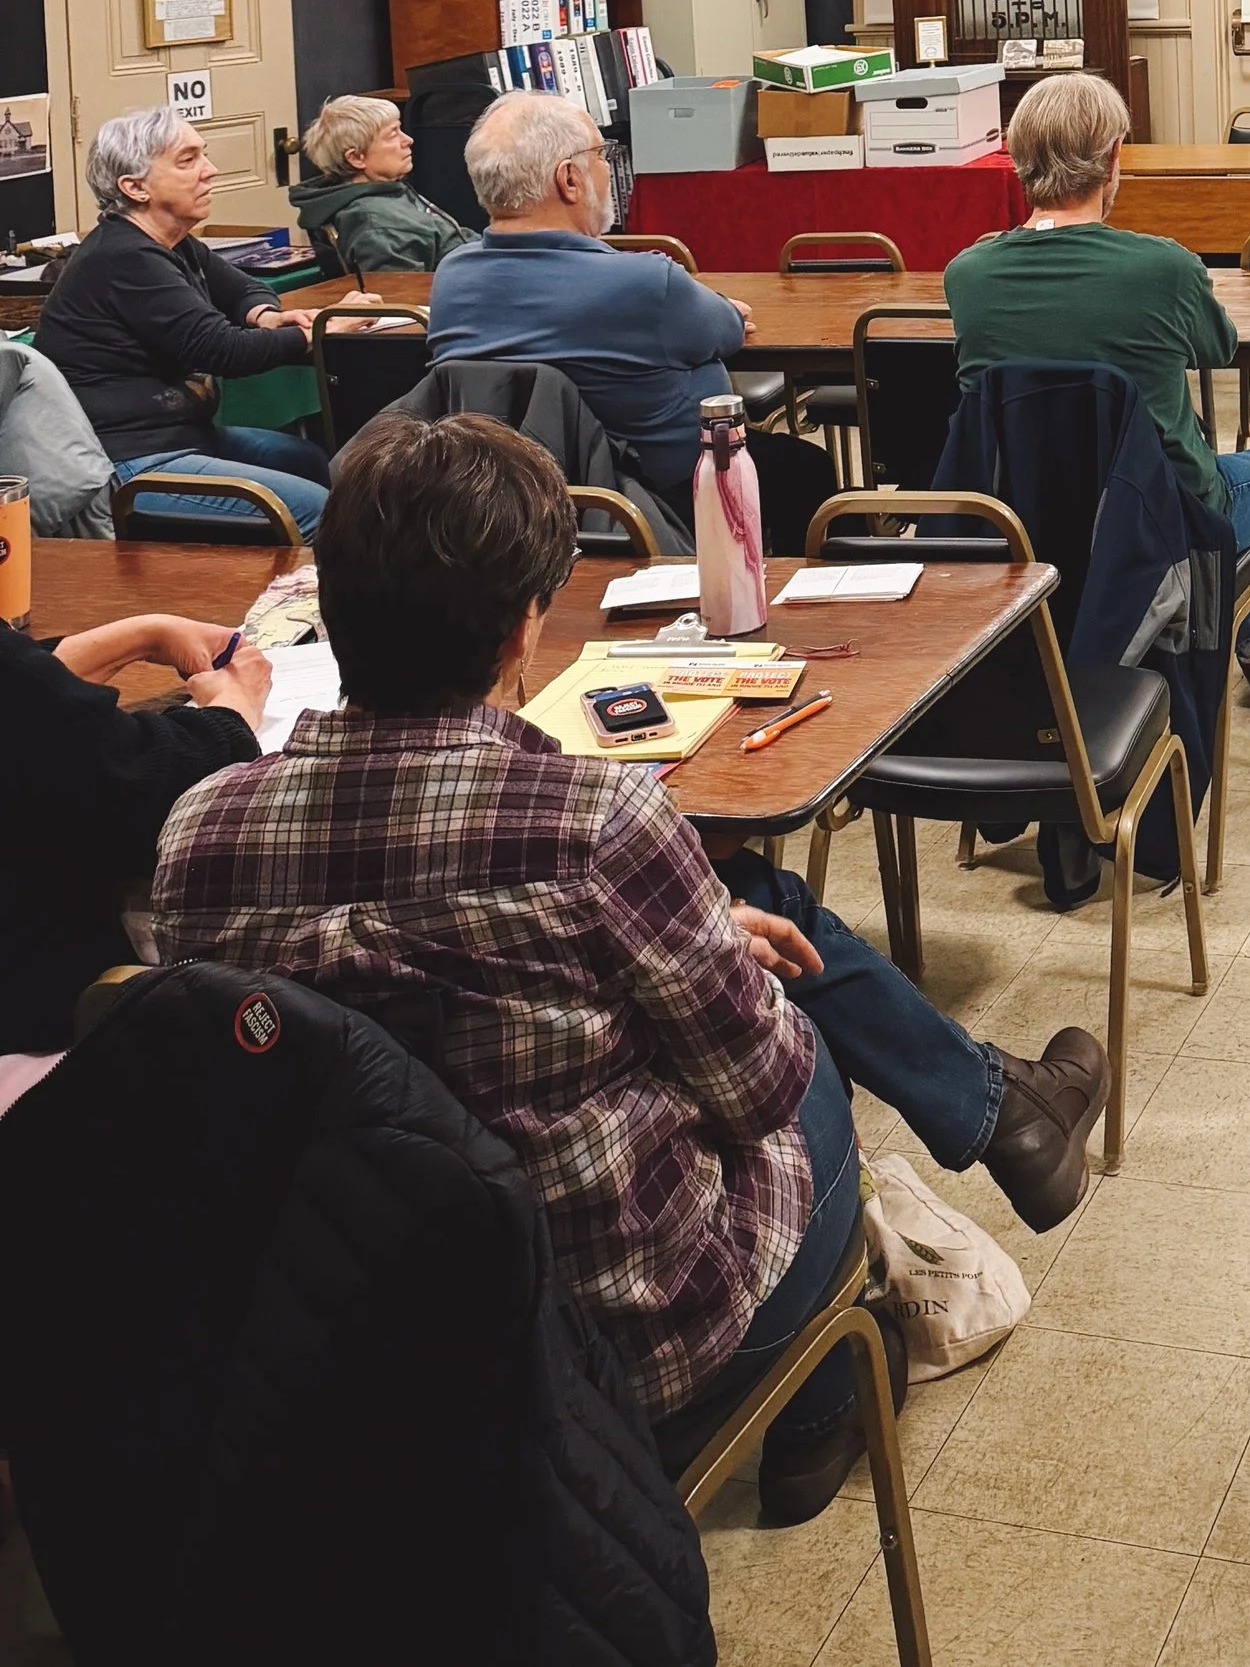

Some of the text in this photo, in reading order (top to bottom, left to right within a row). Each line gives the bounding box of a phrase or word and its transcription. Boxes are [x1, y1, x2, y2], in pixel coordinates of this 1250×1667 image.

[522, 23, 531, 32] A
[533, 23, 540, 32] B
[173, 80, 206, 101] NO
[694, 676, 725, 684] VOTE
[761, 677, 792, 685] VOTE
[252, 1001, 276, 1034] REJECT
[242, 1008, 269, 1045] FASCISM
[927, 1270, 960, 1279] PETITS
[893, 1299, 949, 1319] RDIN
